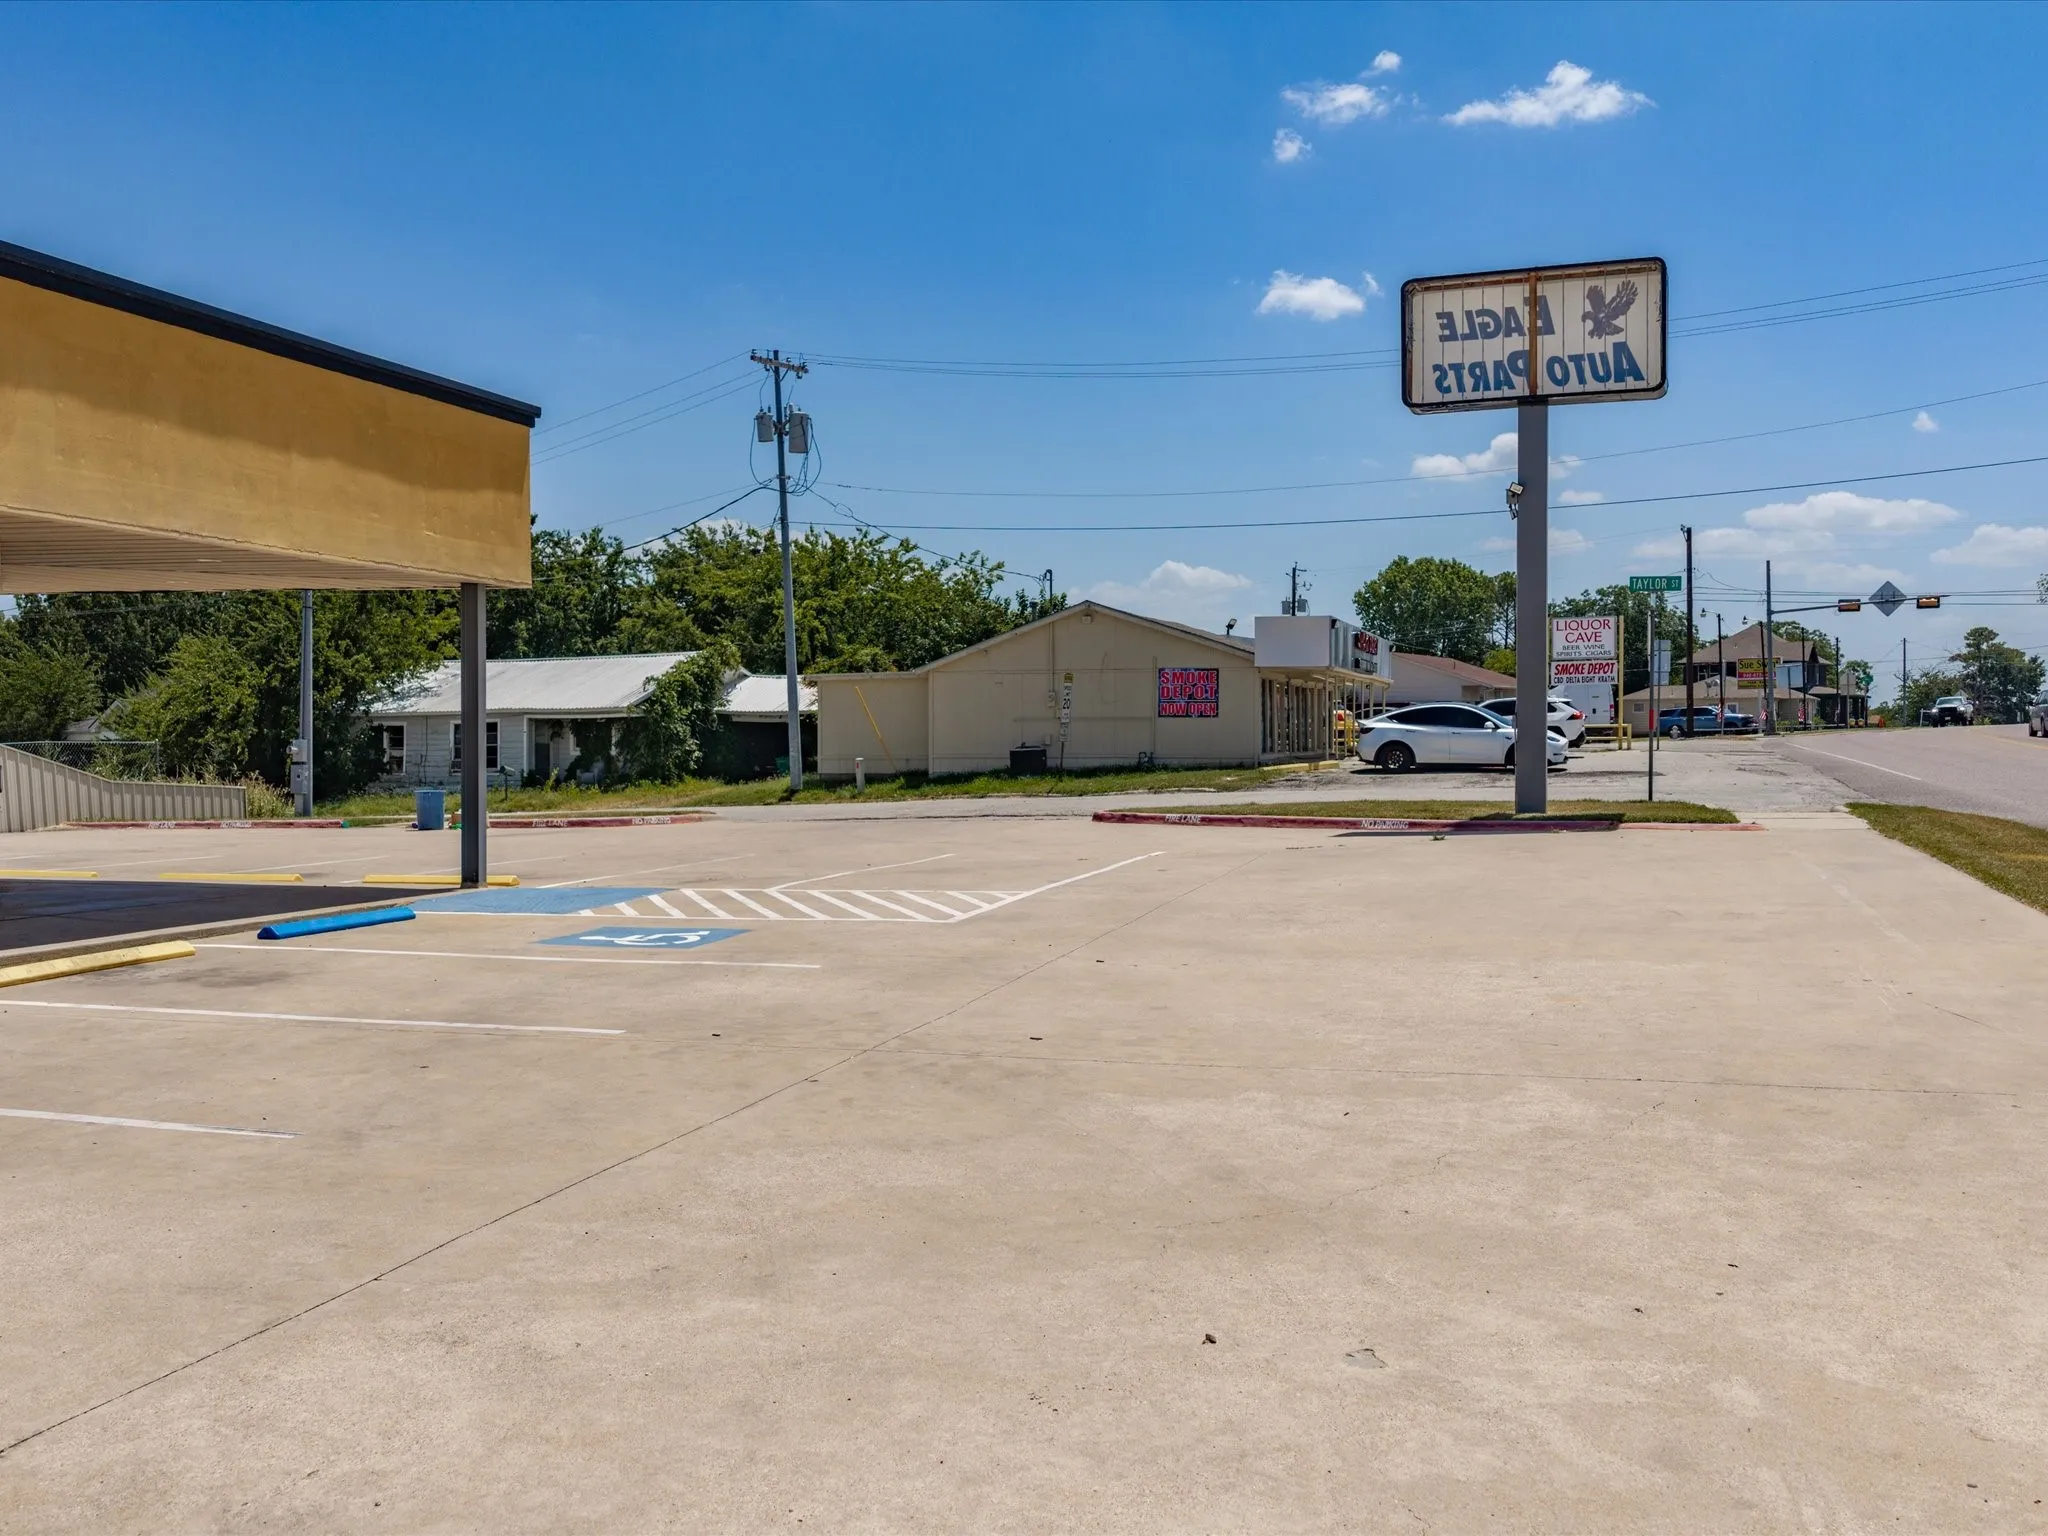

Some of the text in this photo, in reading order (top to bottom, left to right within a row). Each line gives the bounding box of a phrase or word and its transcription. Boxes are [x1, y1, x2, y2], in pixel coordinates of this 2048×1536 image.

[1632, 578, 1679, 589] TAYLOR ST
[1556, 619, 1611, 631] LIQUOR
[1565, 631, 1603, 643] CAVE
[1554, 662, 1615, 675] SMOKE DEPOT
[1739, 660, 1754, 669] Sue
[1160, 671, 1217, 685] SMOKE
[1566, 676, 1581, 684] DELTA
[1160, 685, 1217, 699] DEPOT
[1062, 698, 1070, 709] 20
[1160, 703, 1217, 716] NOW OPEN
[1182, 814, 1201, 824] LANE
[1361, 820, 1409, 829] NO PARKING
